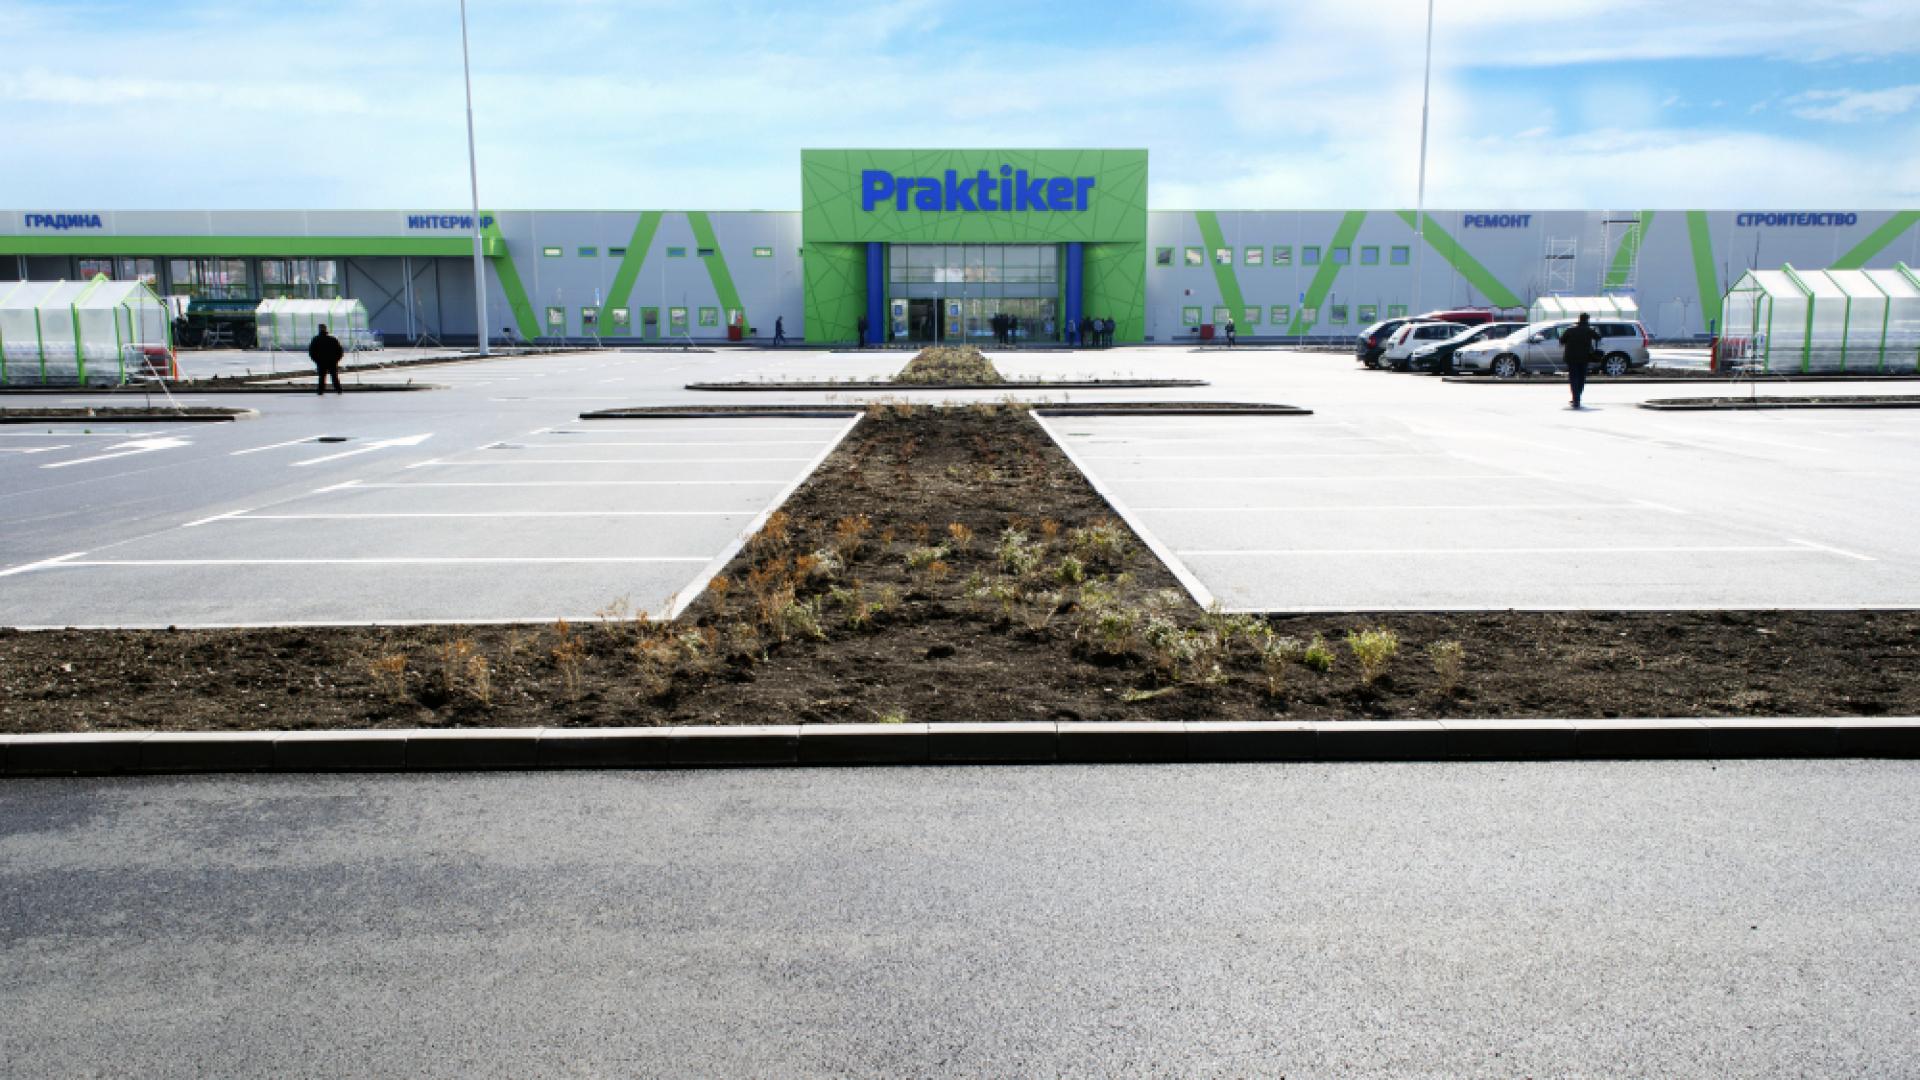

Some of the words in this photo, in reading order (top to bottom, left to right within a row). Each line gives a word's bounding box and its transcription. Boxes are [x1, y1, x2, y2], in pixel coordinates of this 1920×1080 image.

[862, 164, 1096, 212] Praktiker
[24, 214, 103, 230] ГРАДИНА
[1463, 214, 1532, 228] РЕМОНТ
[1736, 212, 1858, 227] СТРОИТЕЛСТВО
